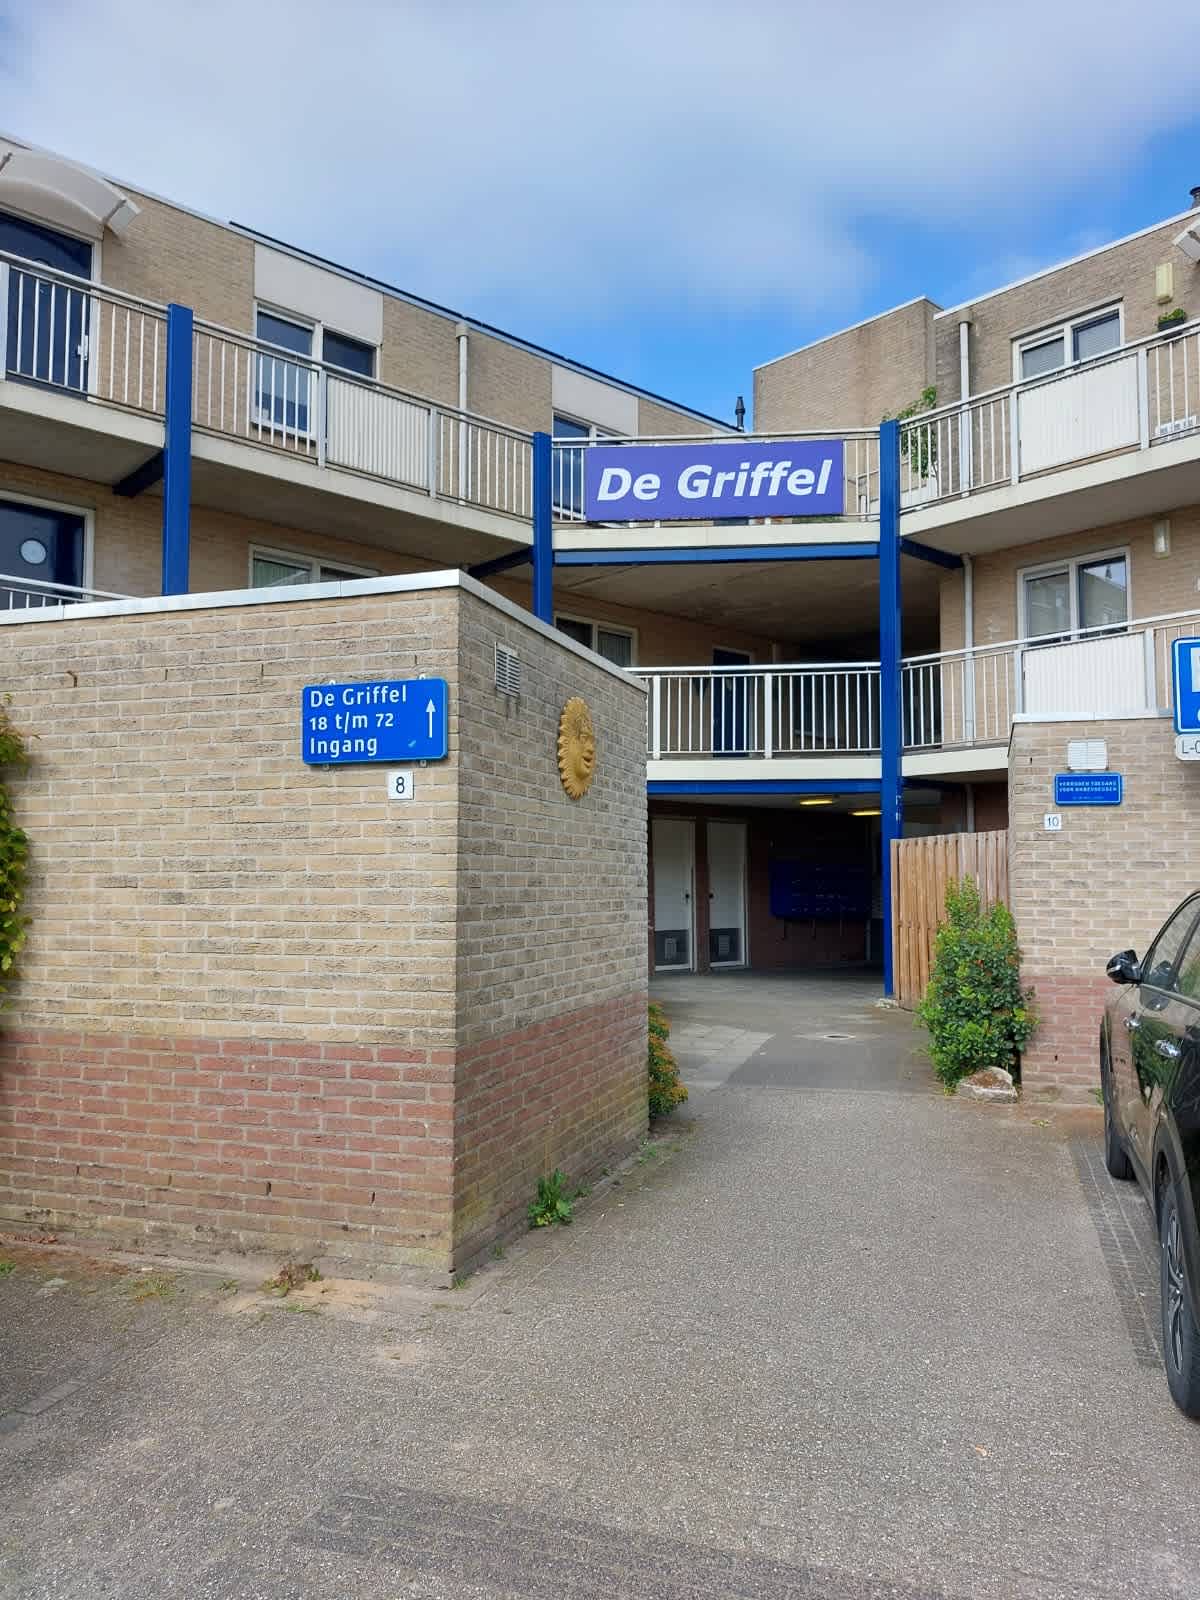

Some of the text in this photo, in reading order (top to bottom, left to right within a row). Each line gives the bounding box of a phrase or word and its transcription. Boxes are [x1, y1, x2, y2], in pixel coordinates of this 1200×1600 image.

[597, 459, 833, 501] De Griffel
[310, 684, 407, 708] De Griffel
[309, 711, 394, 733] 18 t/m 72
[310, 737, 378, 758] Ingang
[395, 776, 405, 794] 8
[1048, 817, 1060, 827] 10
